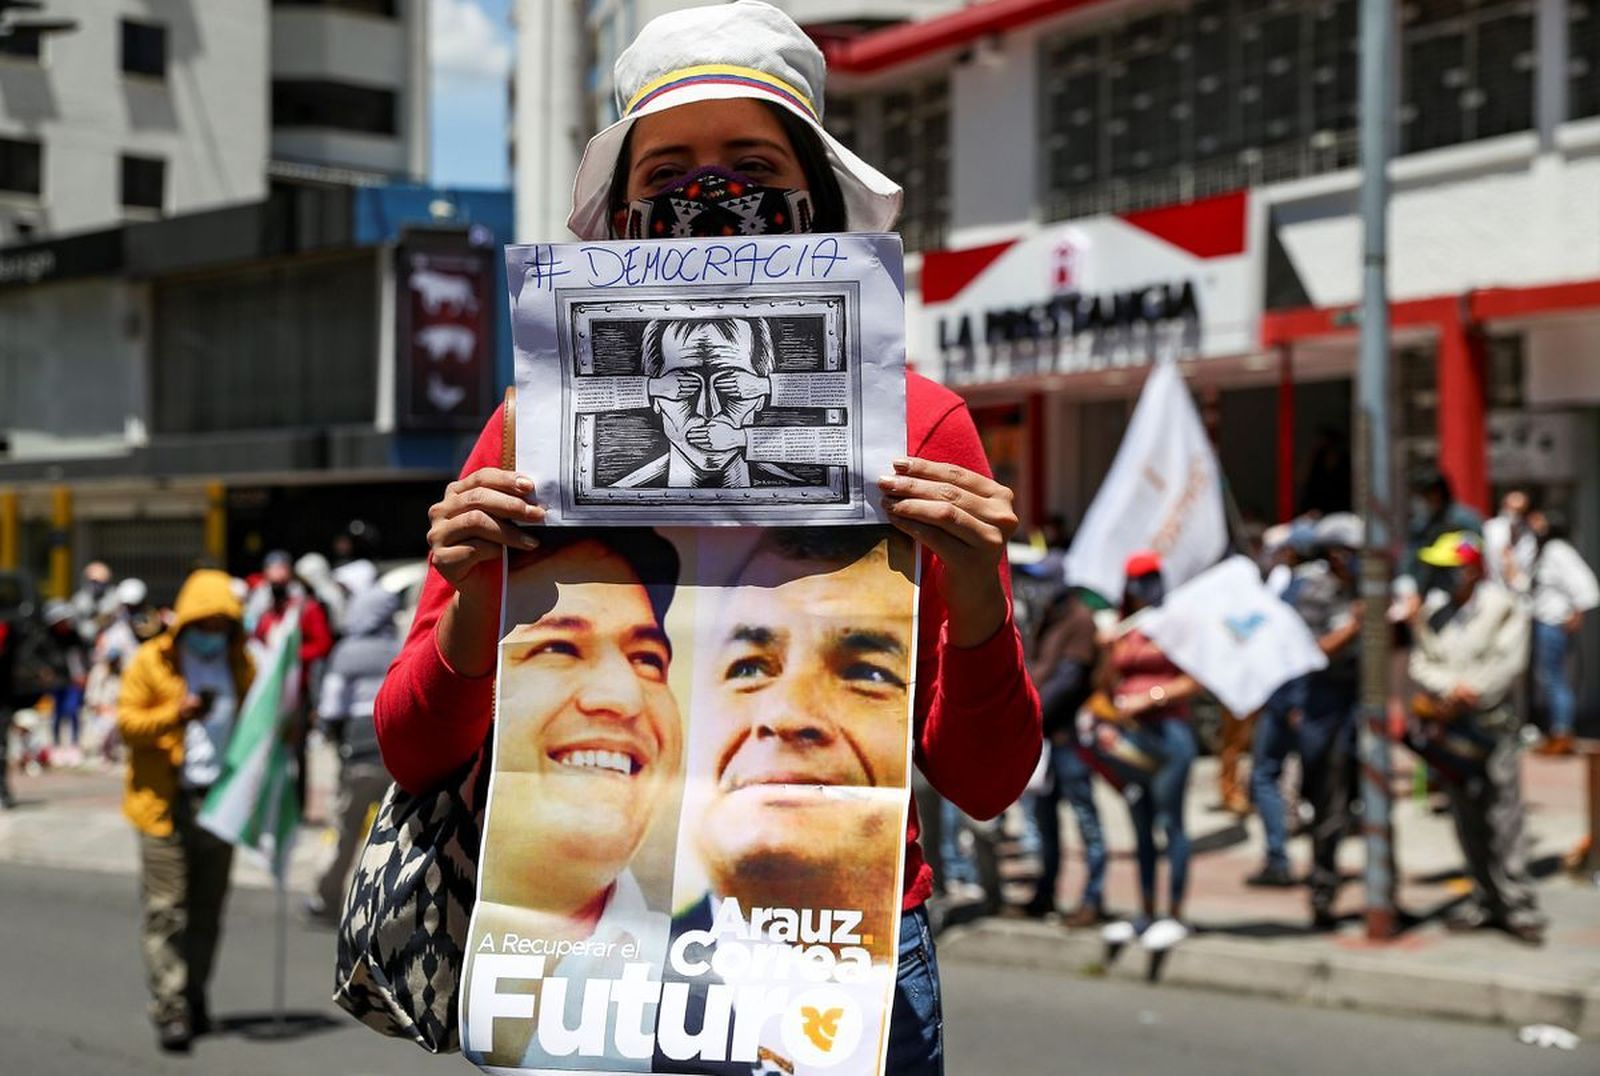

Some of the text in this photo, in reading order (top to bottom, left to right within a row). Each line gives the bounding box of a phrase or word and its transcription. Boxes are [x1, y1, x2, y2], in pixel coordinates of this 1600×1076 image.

[477, 932, 641, 959] A Recuperar el
[670, 929, 873, 983] Correa
[469, 953, 863, 1068] Futuro
